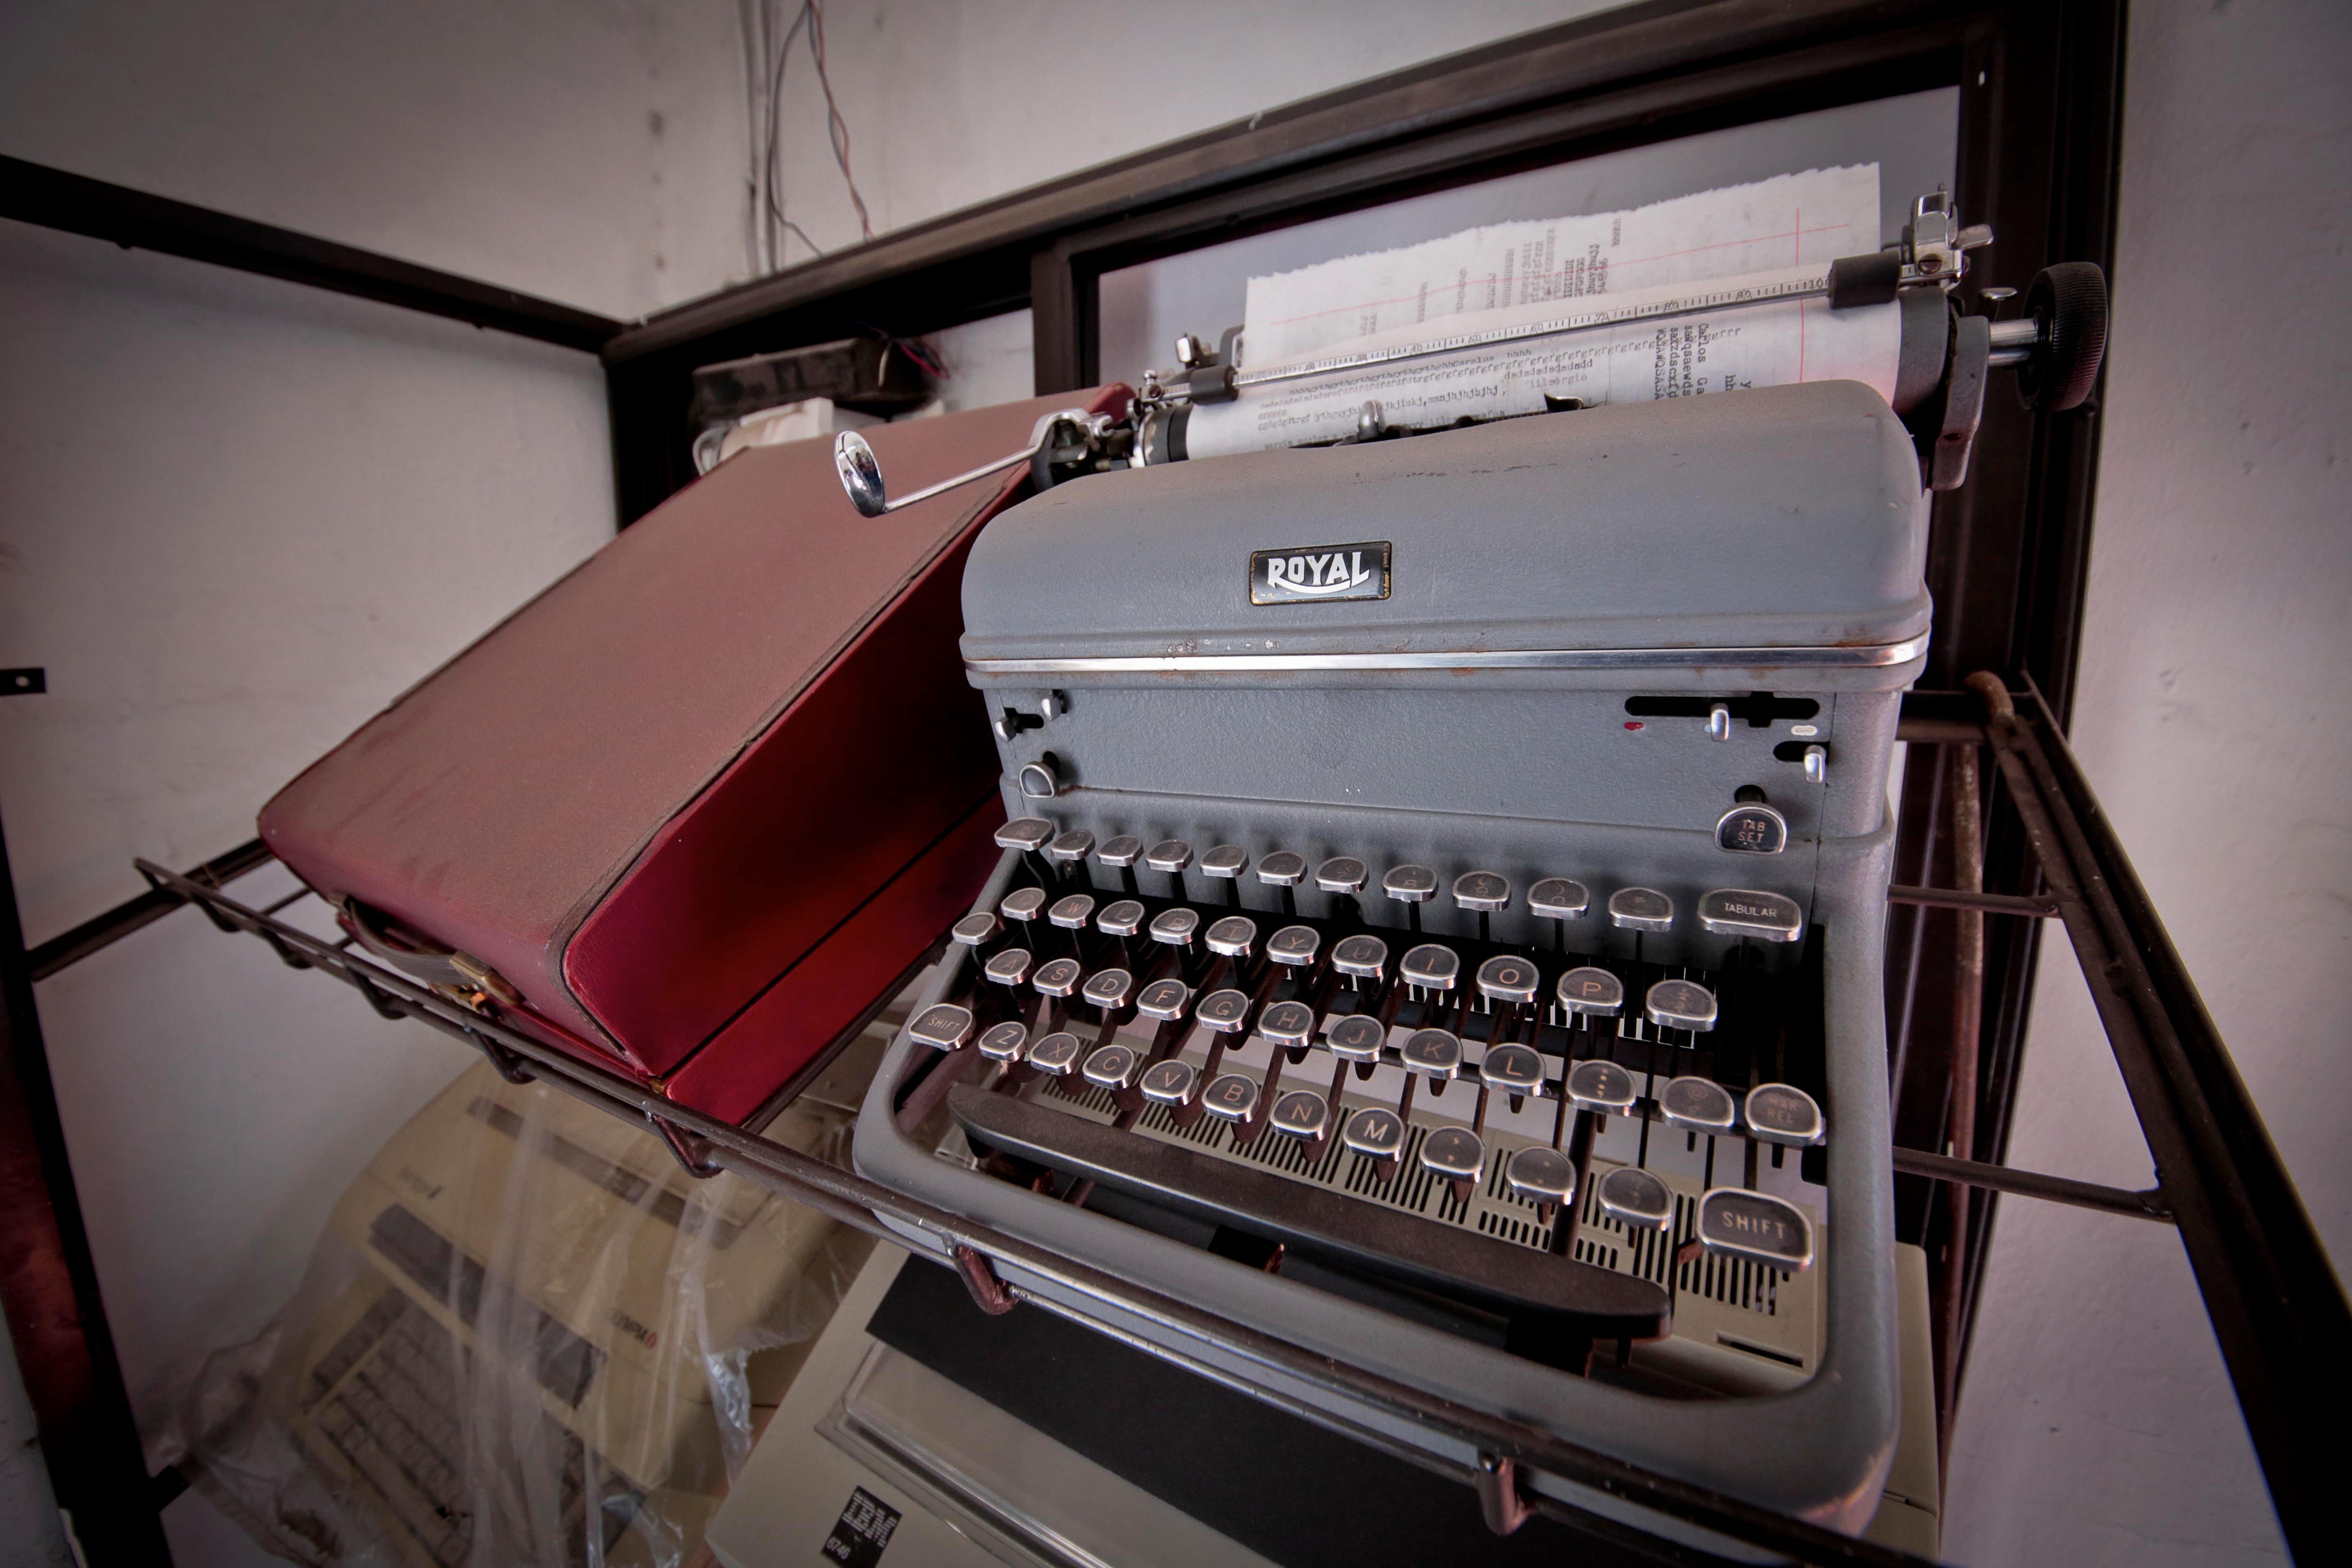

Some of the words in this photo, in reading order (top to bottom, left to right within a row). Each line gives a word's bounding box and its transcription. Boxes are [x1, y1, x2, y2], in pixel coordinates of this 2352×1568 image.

[1470, 334, 1481, 343] 50
[1596, 313, 1608, 322] 70
[1665, 301, 1678, 310] 80
[1737, 290, 1751, 299] 90
[1698, 323, 1709, 363] Carlos
[1267, 551, 1370, 594] ROYAL
[1742, 819, 1765, 831] TAB
[1738, 831, 1764, 842] SET
[1067, 902, 1083, 913] W
[1724, 903, 1777, 916] TABULAR
[1228, 924, 1243, 936] T
[1290, 936, 1305, 948] Y
[1354, 947, 1372, 960] U
[1006, 959, 1018, 971] A
[1426, 957, 1435, 972] I
[1051, 968, 1068, 981] S
[1499, 968, 1520, 985] O
[1100, 978, 1119, 992] D
[1582, 981, 1602, 997] P
[1155, 990, 1176, 1003] F
[1215, 1001, 1233, 1016] G
[929, 1014, 961, 1031] SHIFT
[1277, 1011, 1299, 1028] H
[1000, 1030, 1017, 1045] Z
[1347, 1029, 1366, 1045] J
[1049, 1043, 1068, 1059] X
[1423, 1042, 1445, 1059] K
[1102, 1056, 1120, 1071] C
[1506, 1056, 1524, 1076] L
[1165, 1071, 1181, 1089] V
[1224, 1083, 1244, 1102] B
[1291, 1103, 1313, 1122] N
[1767, 1108, 1794, 1124] REL
[1363, 1119, 1389, 1142] M
[1722, 1211, 1787, 1240] SHIFT
[842, 1492, 898, 1548] IBM
[826, 1536, 851, 1560] 6746
